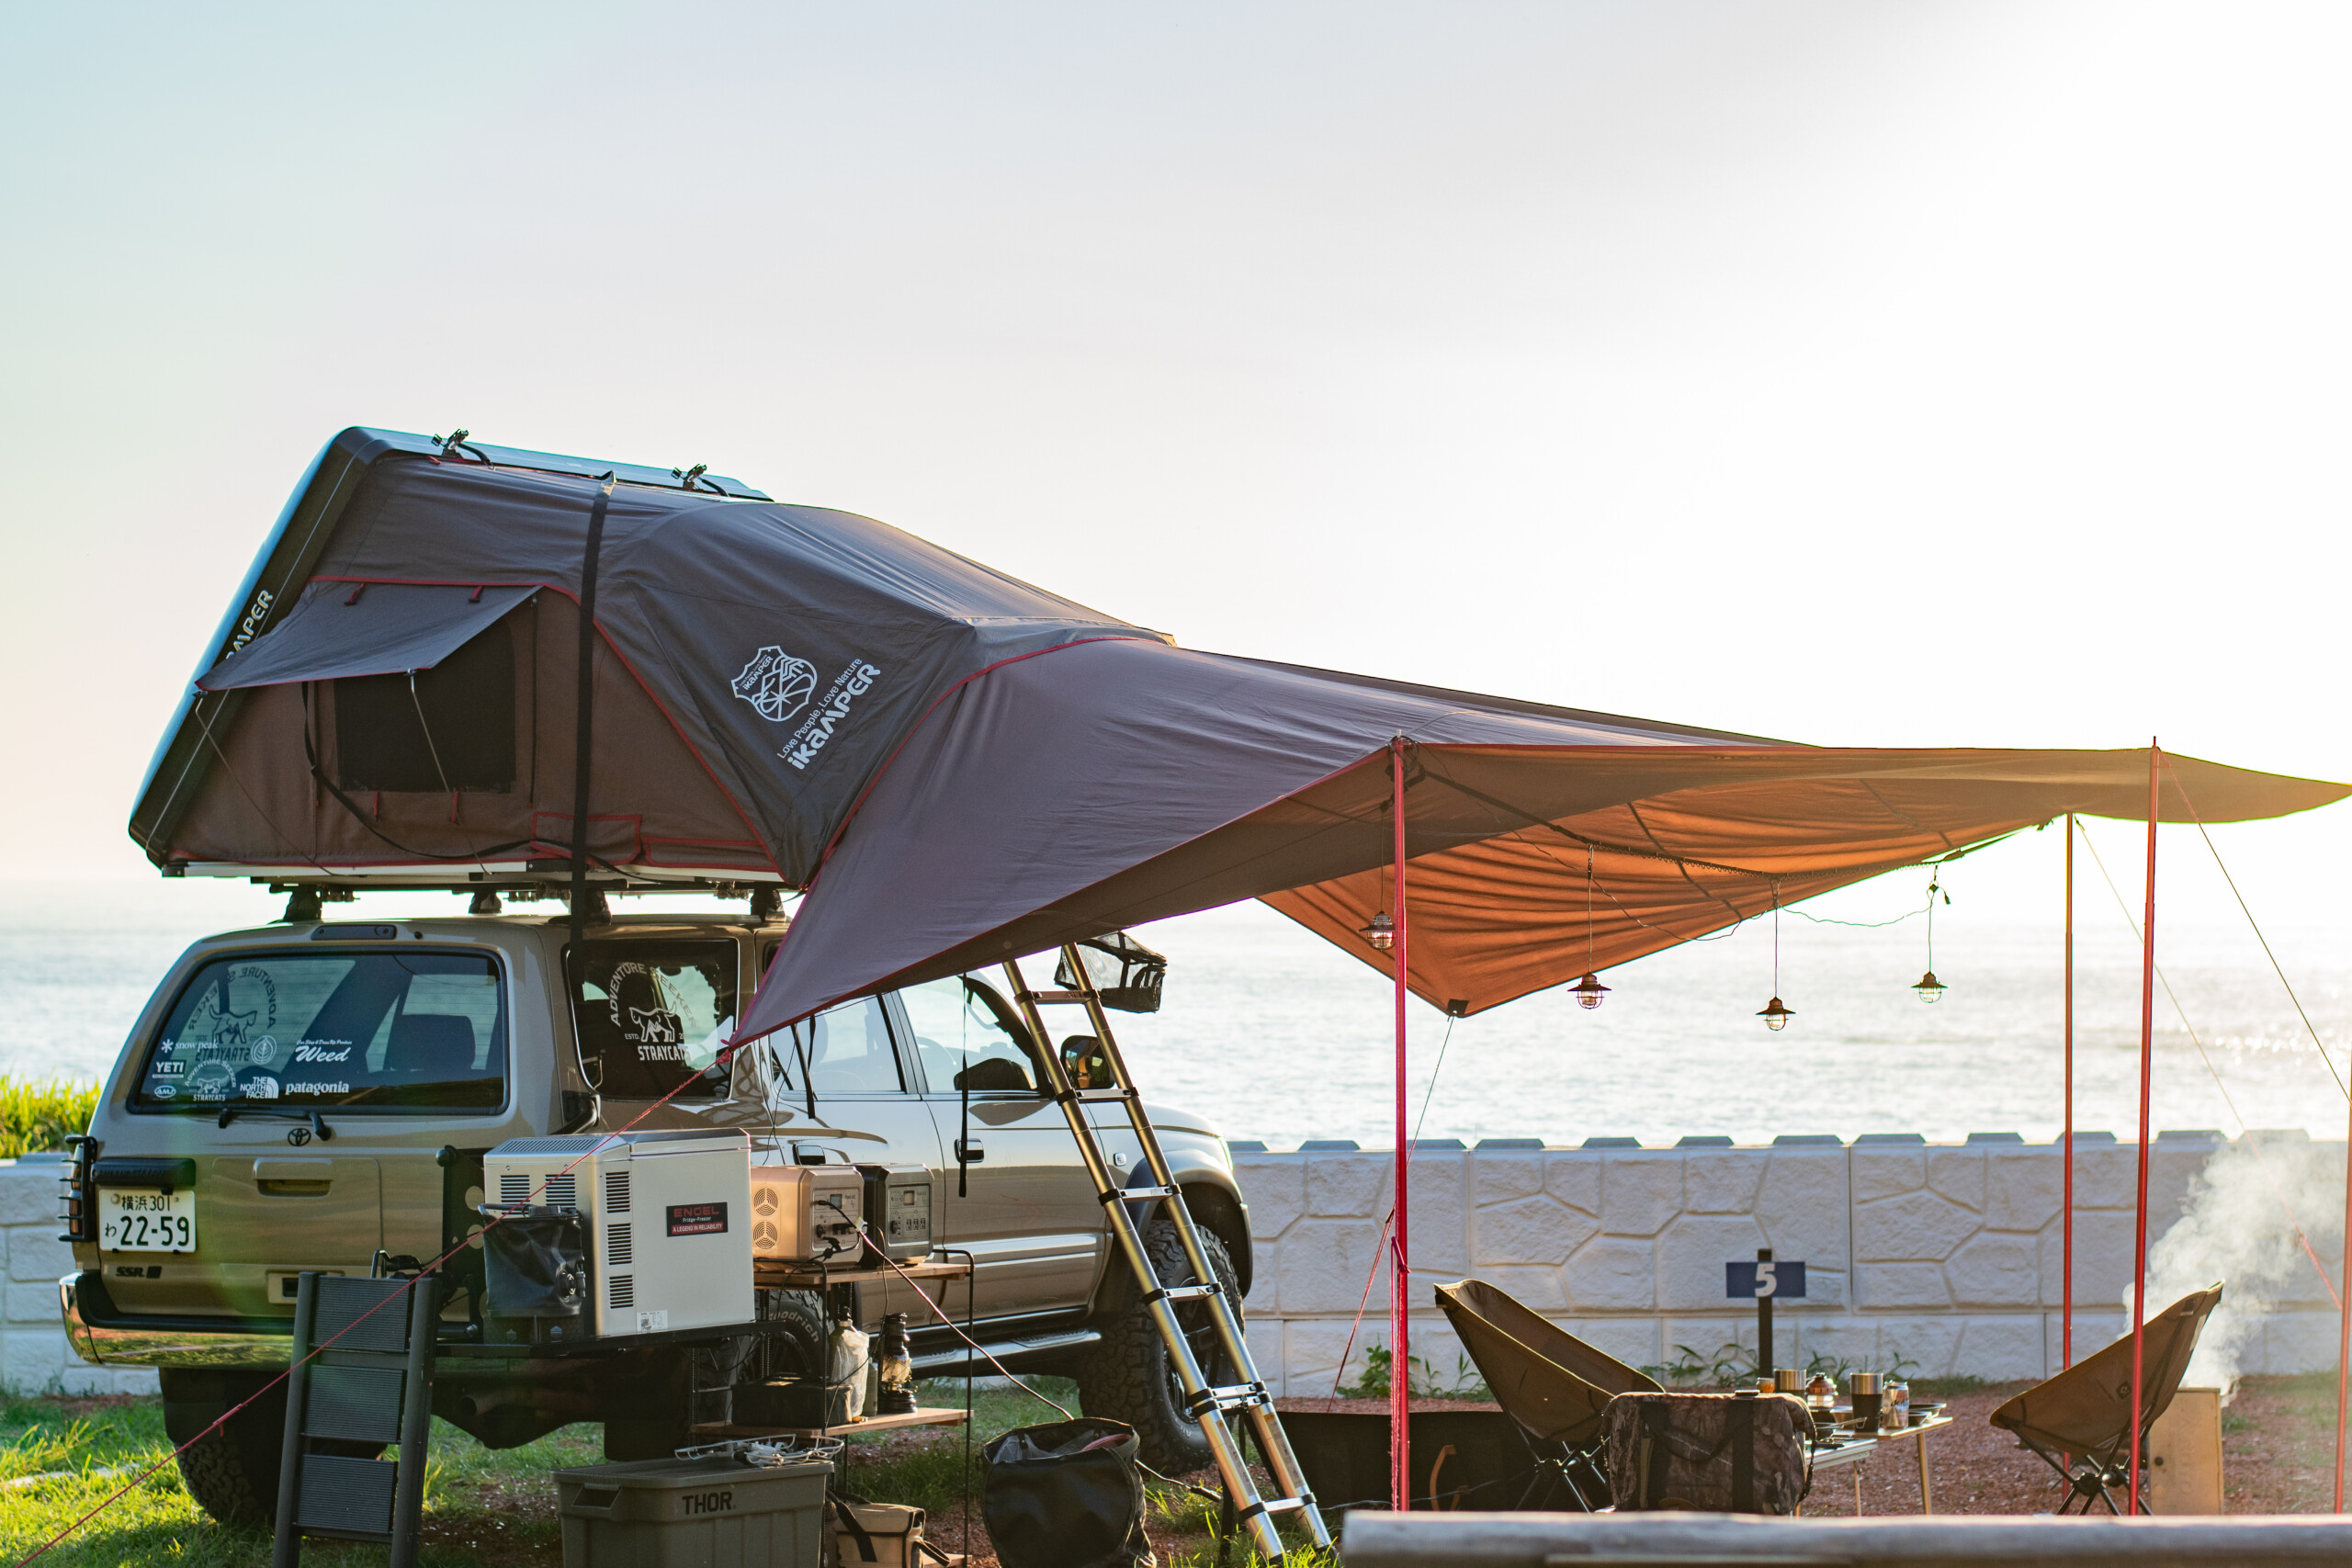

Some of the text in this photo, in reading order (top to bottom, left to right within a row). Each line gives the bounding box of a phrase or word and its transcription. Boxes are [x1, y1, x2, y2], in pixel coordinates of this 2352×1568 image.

[777, 738, 798, 759] Love
[818, 685, 840, 708] Love
[834, 658, 863, 686] Nature
[609, 962, 696, 1029] ADVENTURE SEEKER
[175, 1042, 198, 1050] snow
[197, 1038, 219, 1053] peak
[295, 1045, 351, 1063] Weed
[638, 1045, 689, 1061] STRAYCATS
[156, 1061, 184, 1073] YETI
[185, 1059, 220, 1088] ADVENTURE
[240, 1083, 266, 1092] NORTH
[246, 1090, 265, 1099] FACE
[285, 1080, 350, 1097] patagonia
[193, 1094, 226, 1102] STRAYCATS
[121, 1195, 171, 1212] 横浜 301
[105, 1215, 189, 1247] わ 22-59
[698, 1223, 722, 1231] RELIABILITY
[1755, 1262, 1777, 1297] 5
[682, 1491, 732, 1515] THOR
